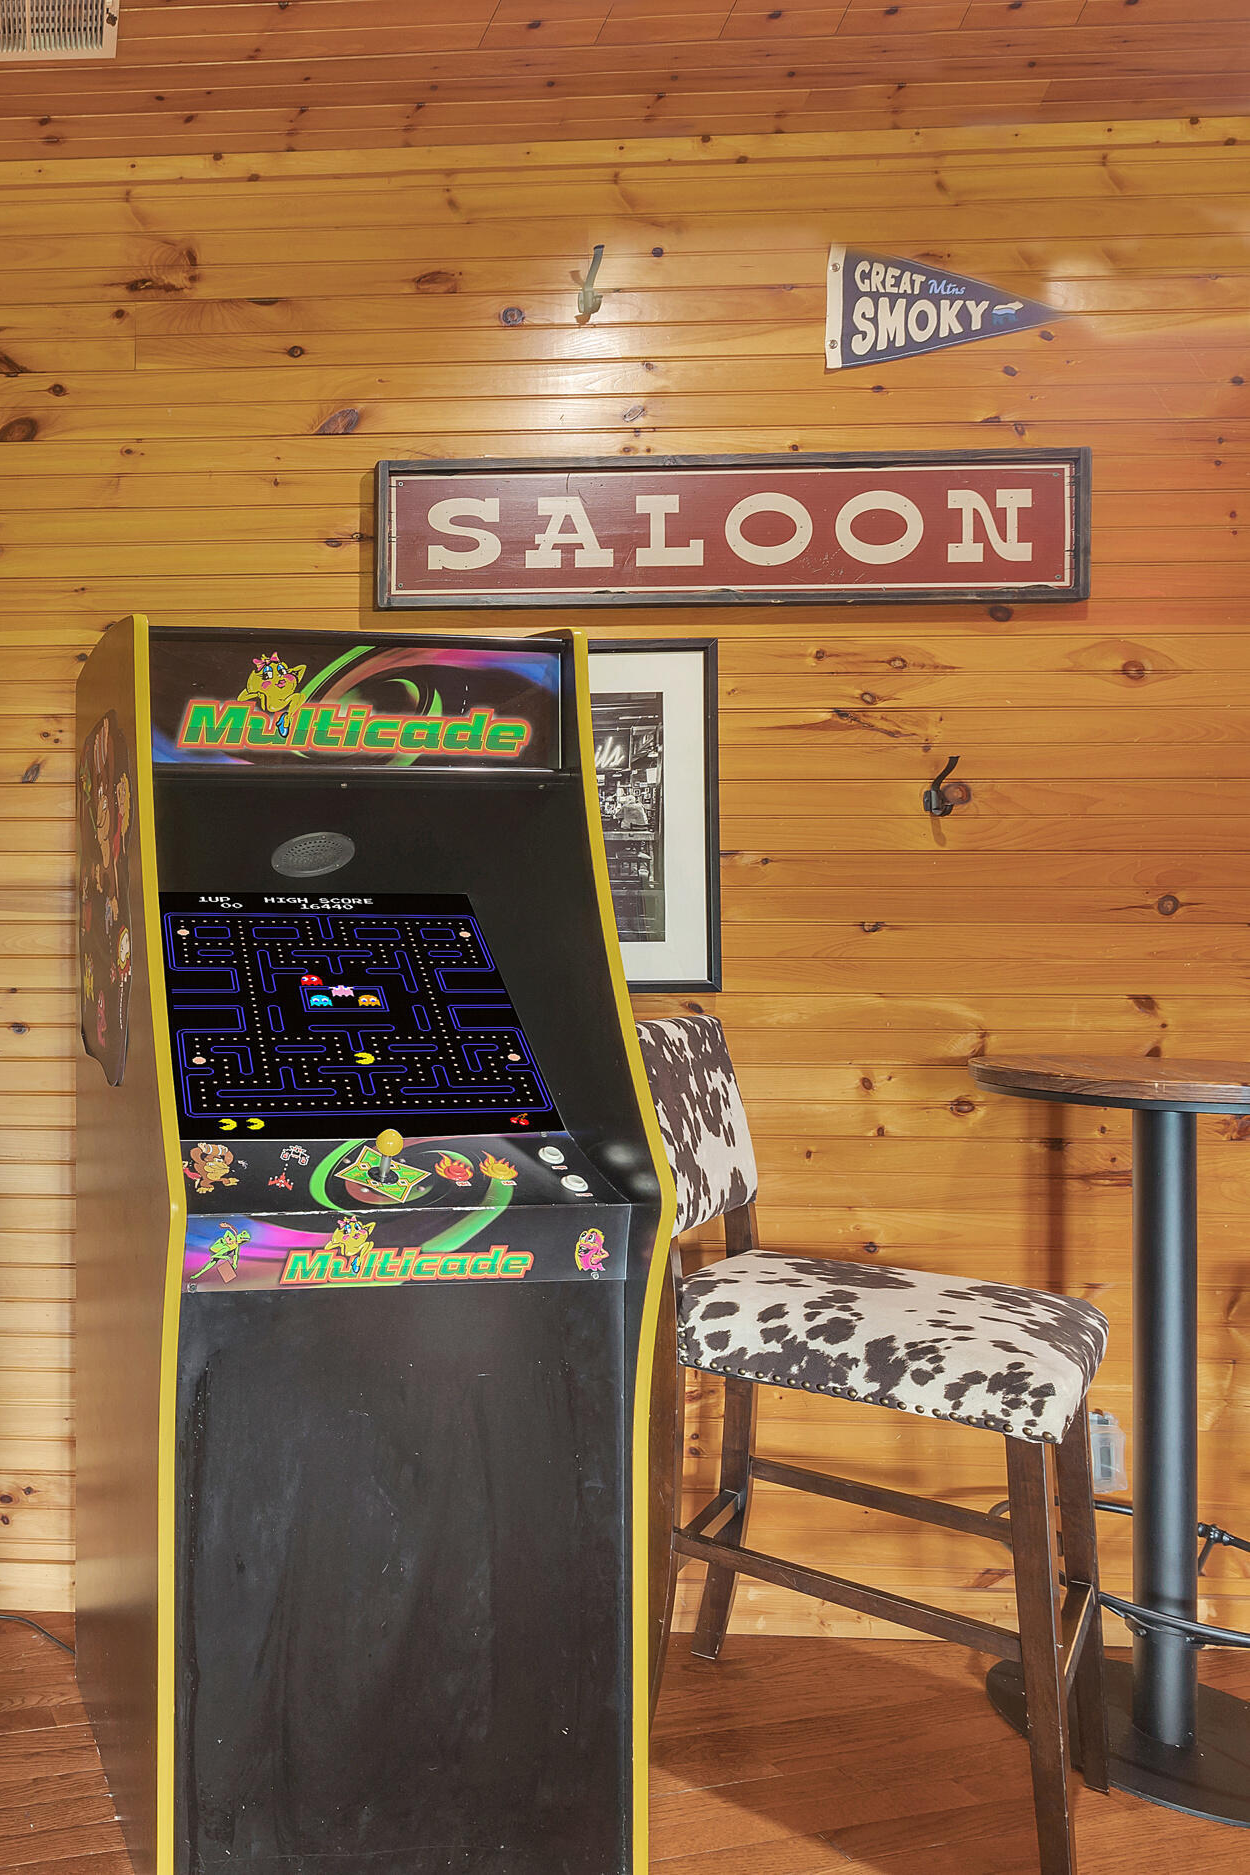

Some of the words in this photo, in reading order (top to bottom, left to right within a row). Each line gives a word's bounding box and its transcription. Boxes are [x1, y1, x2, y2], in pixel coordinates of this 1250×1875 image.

[854, 260, 926, 294] GREAT
[927, 279, 966, 295] Mtns
[851, 296, 989, 356] SMOKY
[427, 488, 1032, 571] SALOON
[179, 699, 531, 757] Multicade
[319, 897, 374, 905] SCORE
[280, 1245, 534, 1285] Multicade
